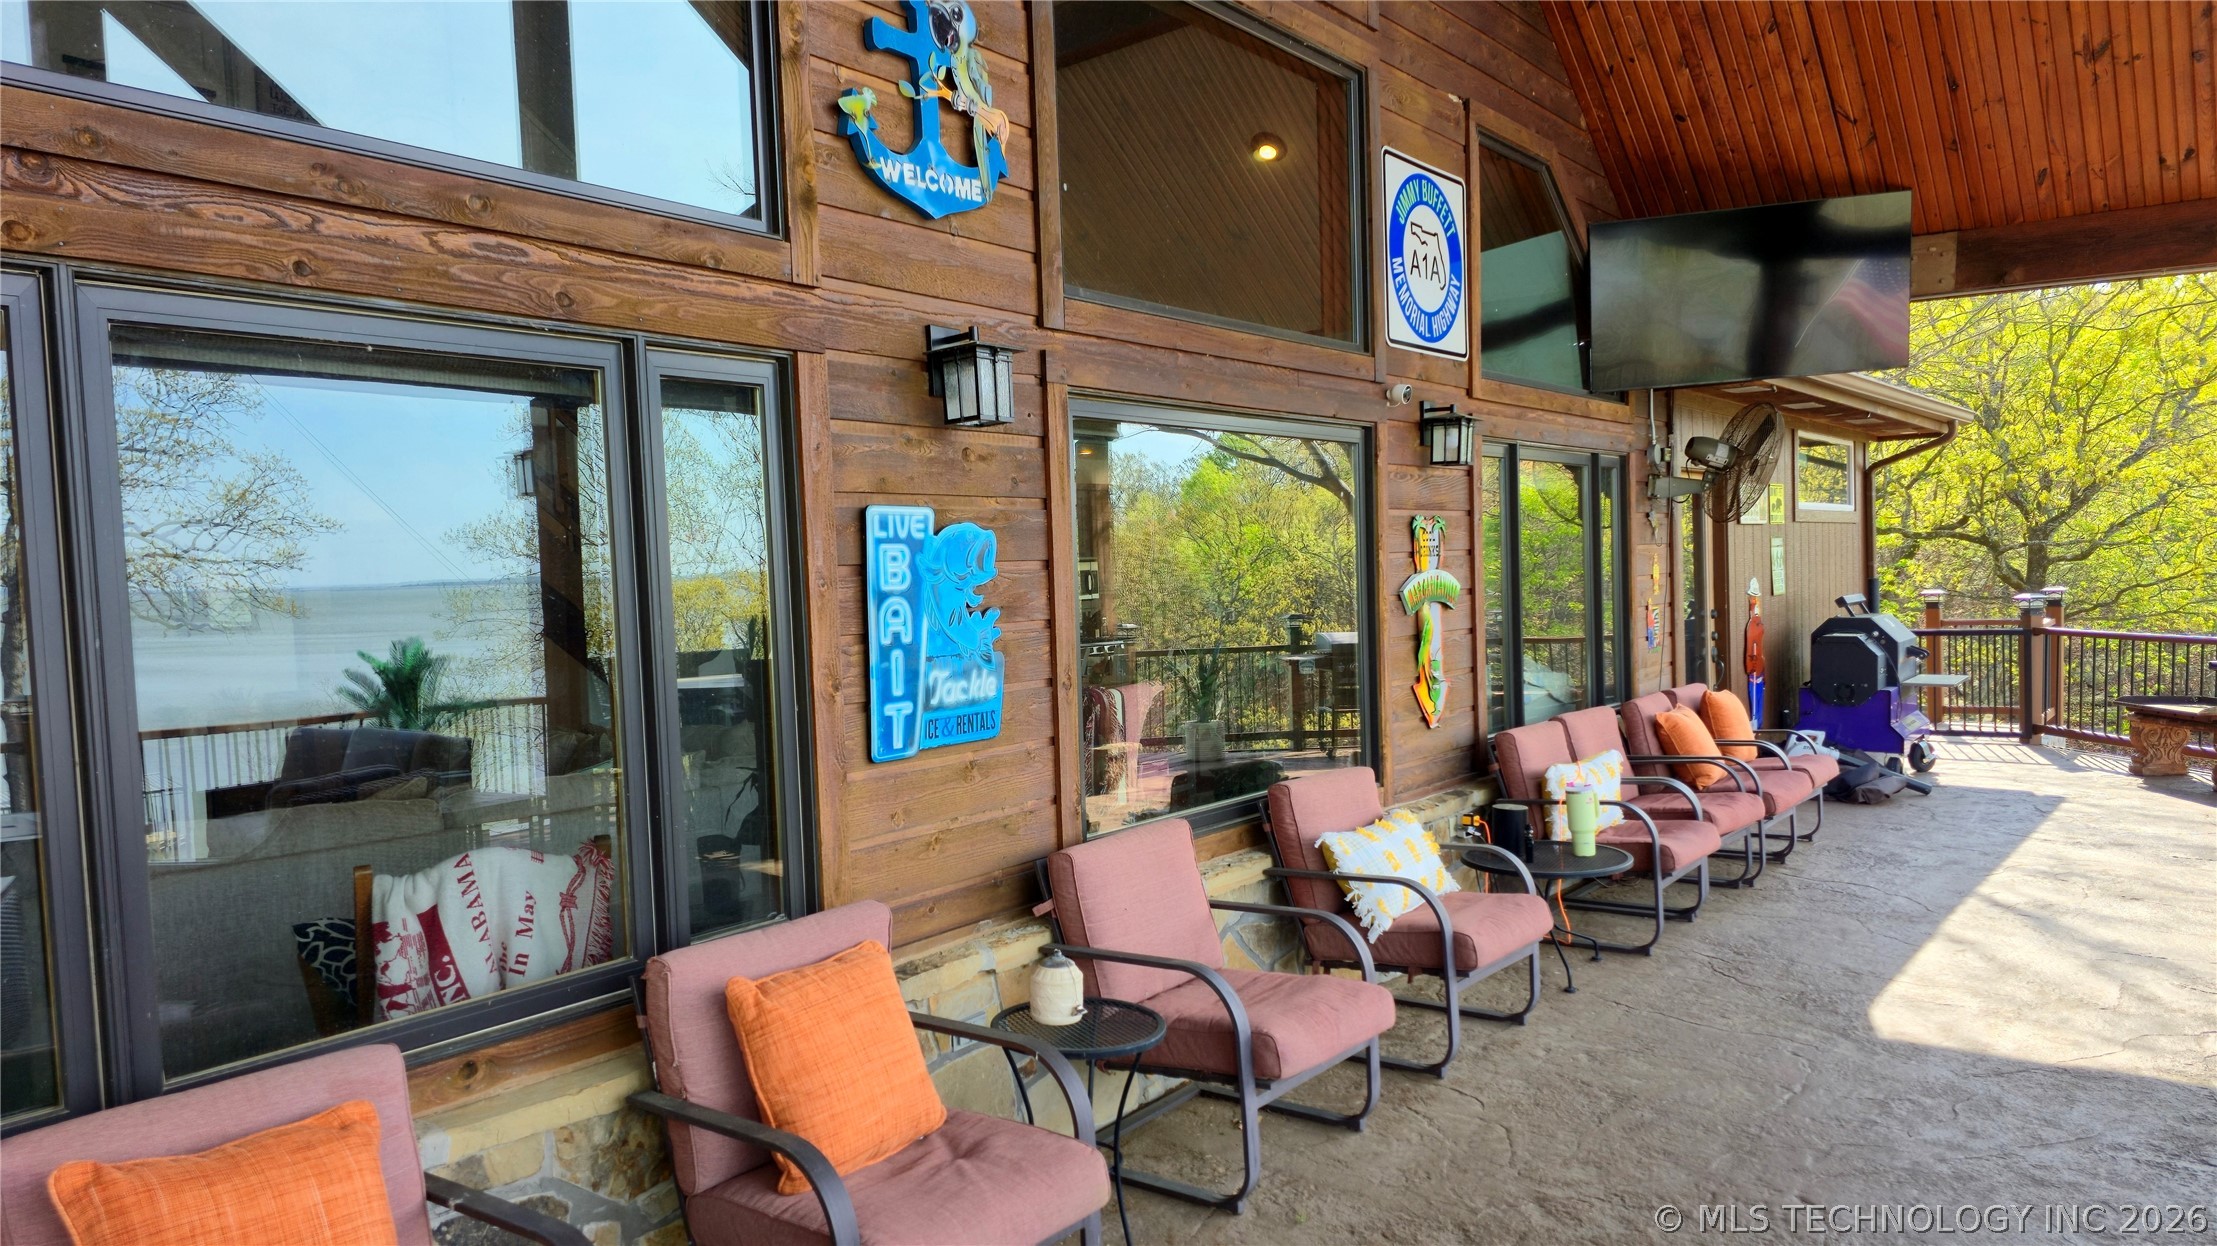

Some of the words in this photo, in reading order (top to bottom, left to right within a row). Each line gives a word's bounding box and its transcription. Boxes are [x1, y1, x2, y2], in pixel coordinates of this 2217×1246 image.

[880, 157, 982, 202] WELCOME
[1395, 179, 1420, 225] JIMMY
[1422, 179, 1455, 237] BUFFETT
[1410, 249, 1441, 283] A1A
[1392, 256, 1431, 337] MEMORIAL
[1432, 273, 1461, 338] HIGHWAY
[873, 514, 926, 539] LIVE
[878, 543, 914, 750] BAIT
[928, 669, 997, 706] Tackle
[924, 717, 940, 740] ICE
[941, 717, 955, 738] &
[956, 710, 996, 735] RENTALS
[515, 890, 536, 939] May
[508, 952, 529, 977] In
